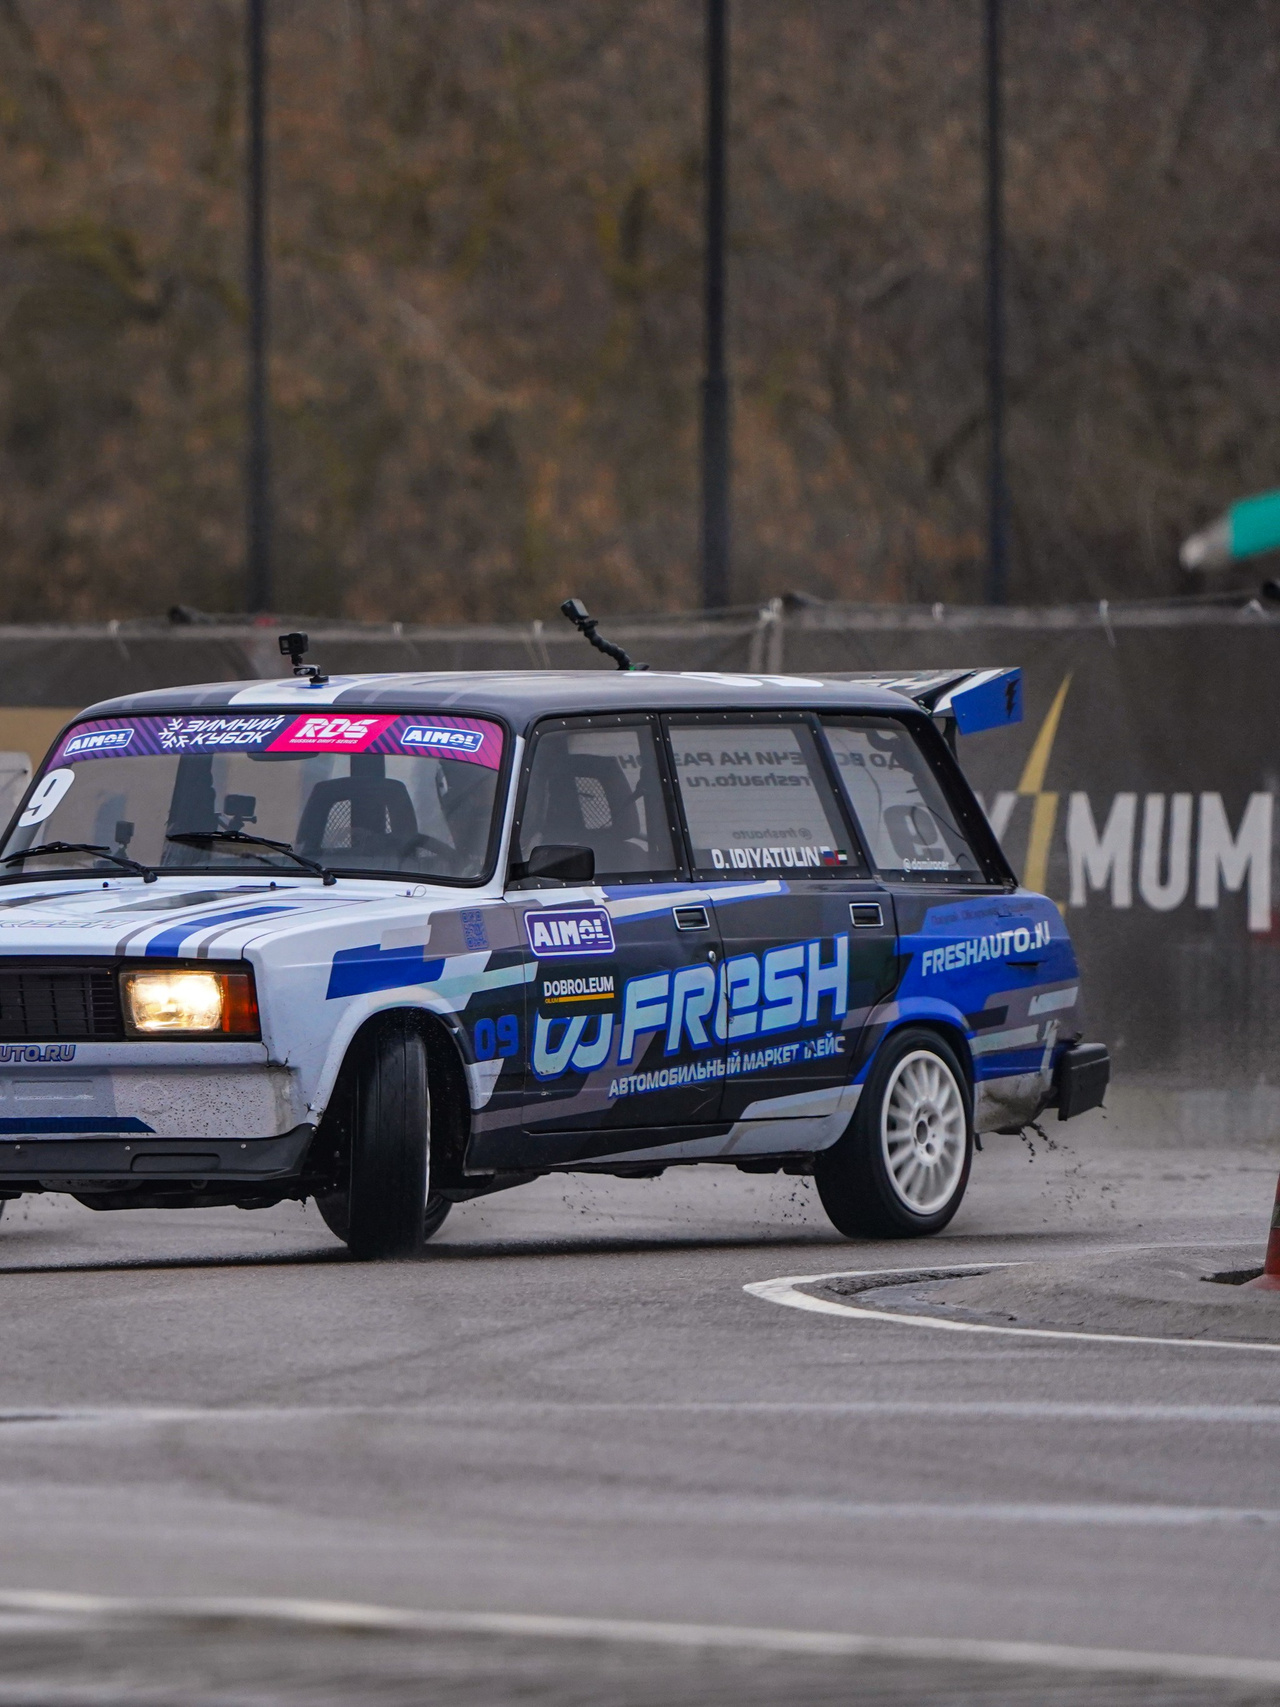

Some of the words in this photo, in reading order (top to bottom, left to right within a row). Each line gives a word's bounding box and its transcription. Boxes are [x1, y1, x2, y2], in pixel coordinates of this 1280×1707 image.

[181, 714, 286, 733] ЗИМНИЙ
[295, 718, 380, 738] RDS
[67, 733, 128, 752] AIMOL
[190, 731, 272, 745] КУБОК
[406, 730, 476, 748] AIMOL
[18, 768, 75, 828] 9
[712, 850, 728, 869] D.
[729, 846, 820, 868] IDIYATULIN
[533, 918, 612, 947] AIMOL
[543, 976, 615, 997] DOBROLEUM
[474, 1014, 519, 1061] 09
[608, 1050, 741, 1098] АВТОМОБИЛЬНЫЙ
